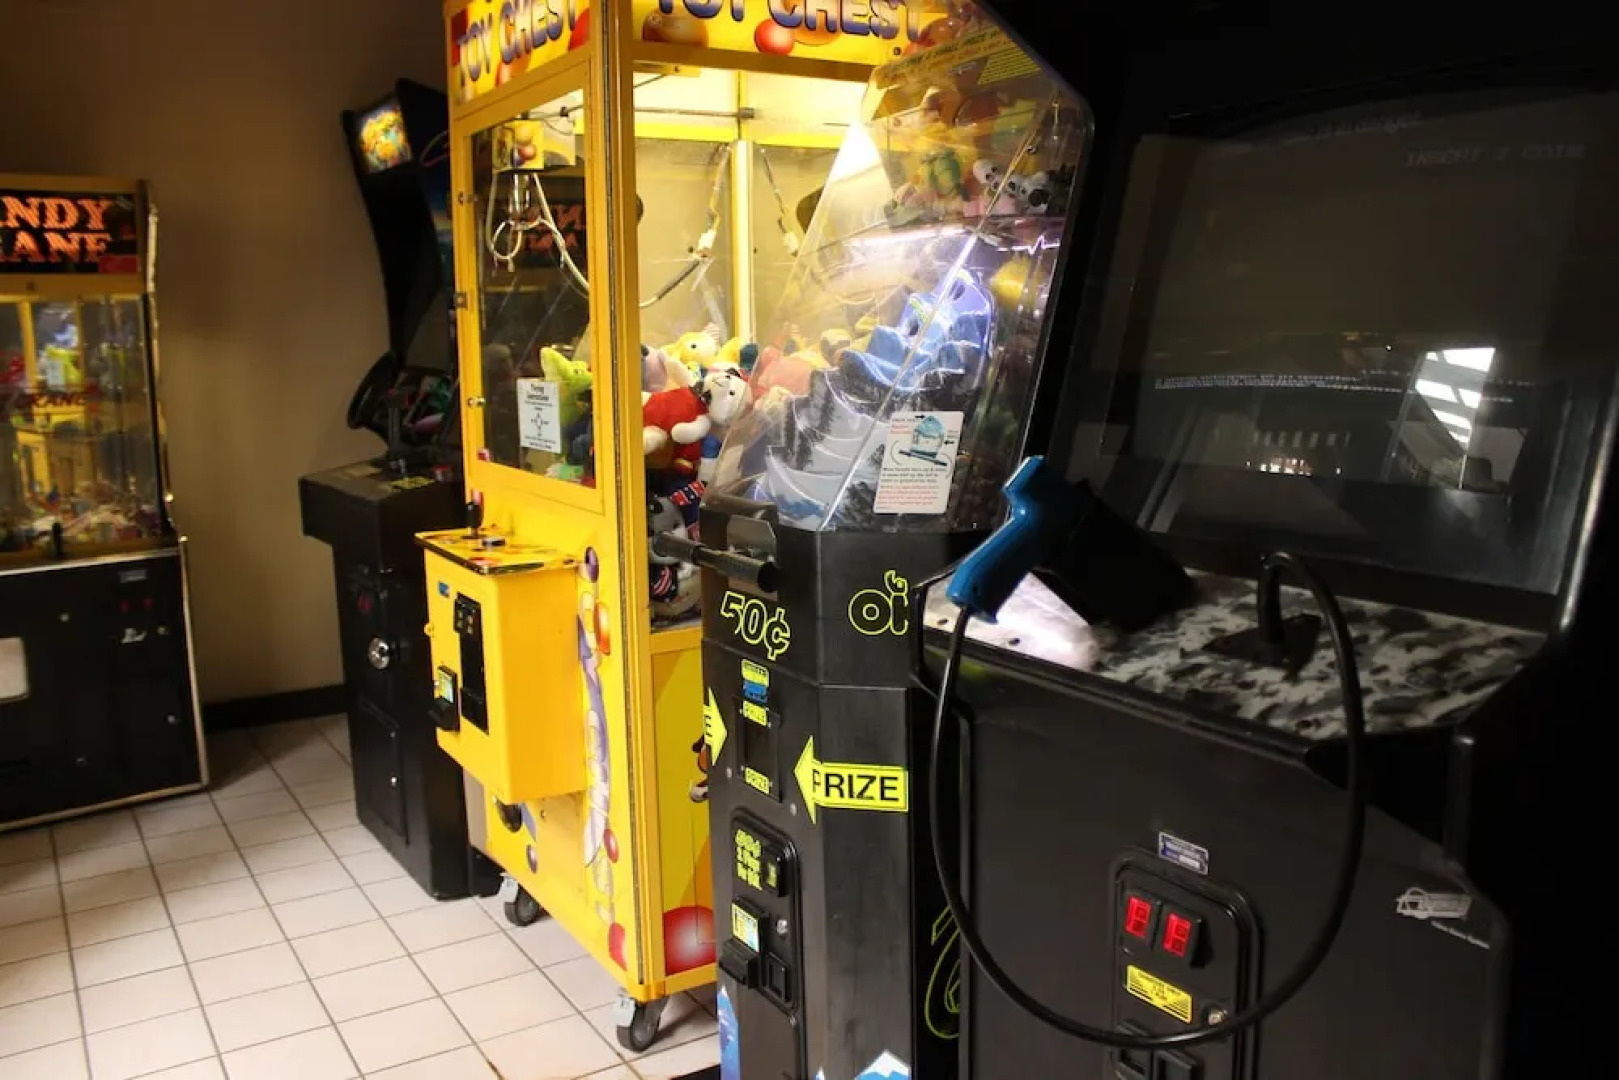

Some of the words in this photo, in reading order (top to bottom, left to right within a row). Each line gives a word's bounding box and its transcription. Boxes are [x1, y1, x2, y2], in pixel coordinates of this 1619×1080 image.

[0, 196, 111, 231] NDY
[0, 231, 112, 264] ANE
[720, 590, 791, 662] 50¢
[813, 769, 900, 802] PRIZE
